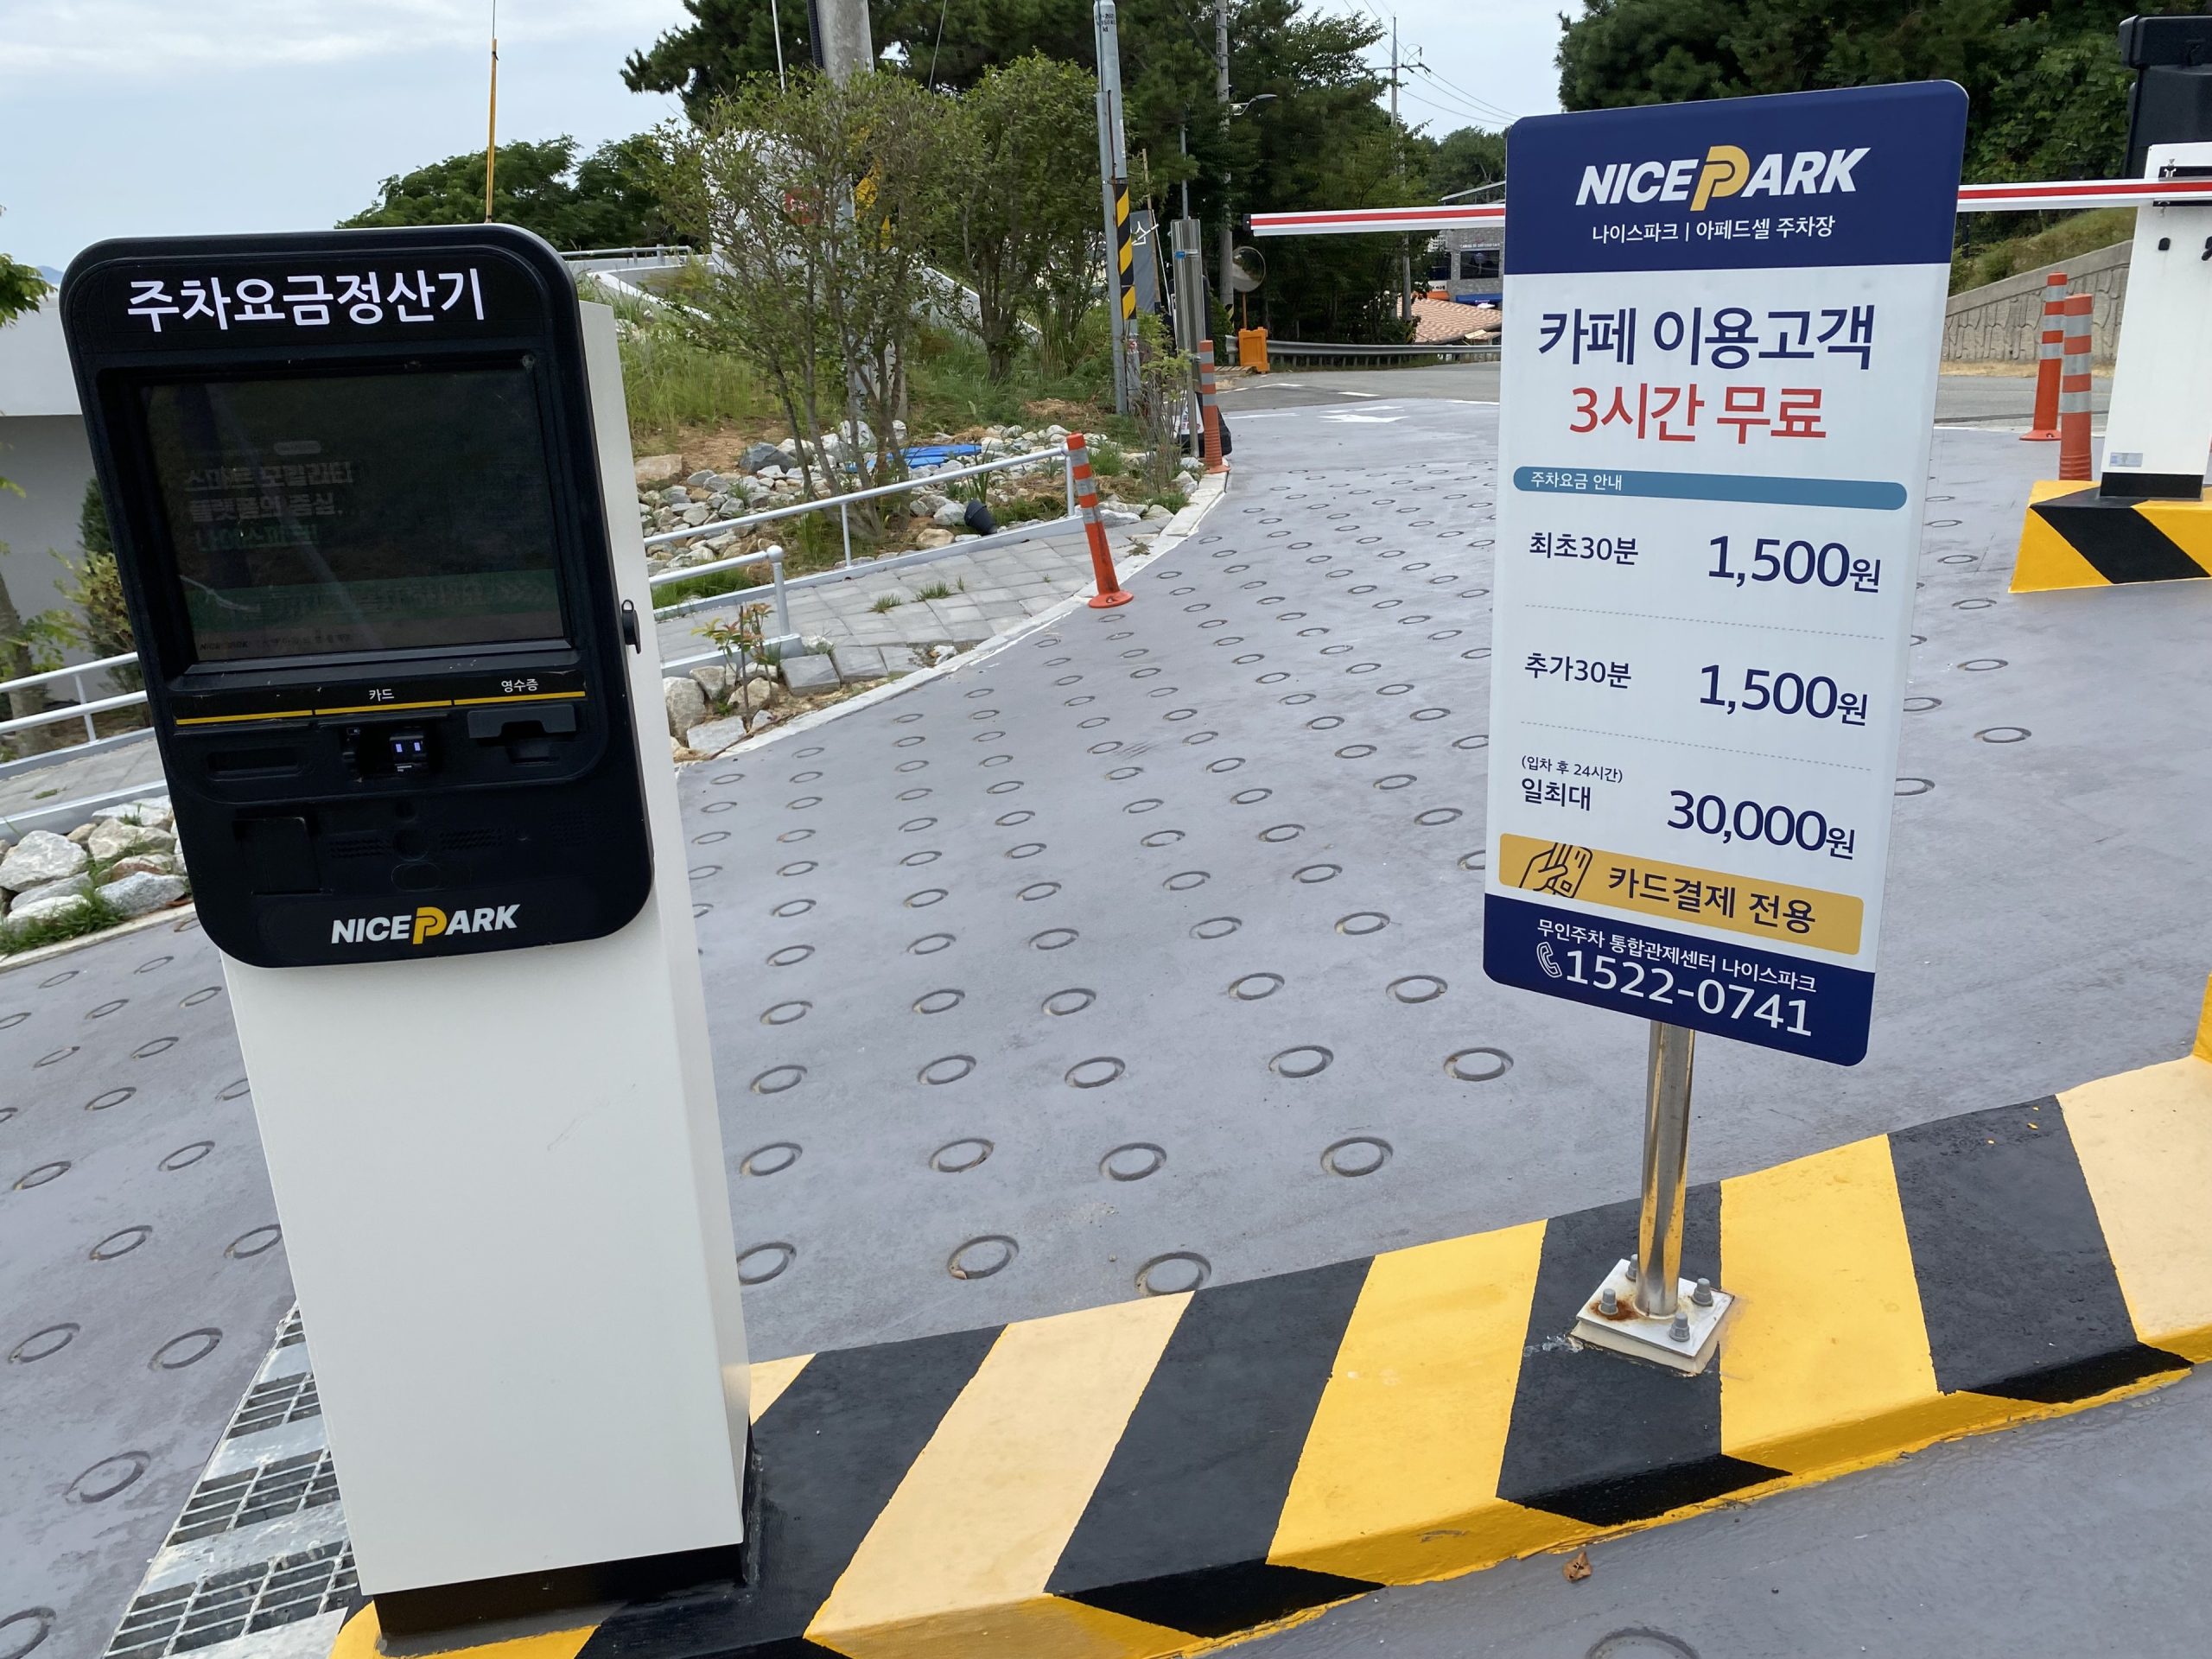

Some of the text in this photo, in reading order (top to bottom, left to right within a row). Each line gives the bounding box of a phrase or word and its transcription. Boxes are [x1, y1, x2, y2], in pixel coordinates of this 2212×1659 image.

[1576, 146, 1871, 211] NICEPARK
[1593, 215, 1835, 244] 나이스파크 아페드셀 주차장
[128, 269, 484, 332] 주차요금정산기
[1539, 305, 1874, 370] 카페 이용고객
[1570, 384, 1826, 444] 3시간 무료
[1530, 471, 1623, 492] 주차요금 안내
[1529, 532, 1880, 593] 최초30분 1,500원
[369, 690, 394, 701] 카드
[501, 679, 538, 692] 영수증
[1525, 653, 1867, 726] 추가30분 1,500원
[1522, 756, 1622, 783] (입차 후 24시간)
[1522, 779, 1854, 860] 일최대 30,000원
[332, 905, 520, 944] NICEPARK
[1609, 868, 1815, 933] 카드결제 전용
[1537, 919, 1816, 993] 무인주차 통합관제센터 나이스파크
[1567, 950, 1812, 1037] 1522-0741
